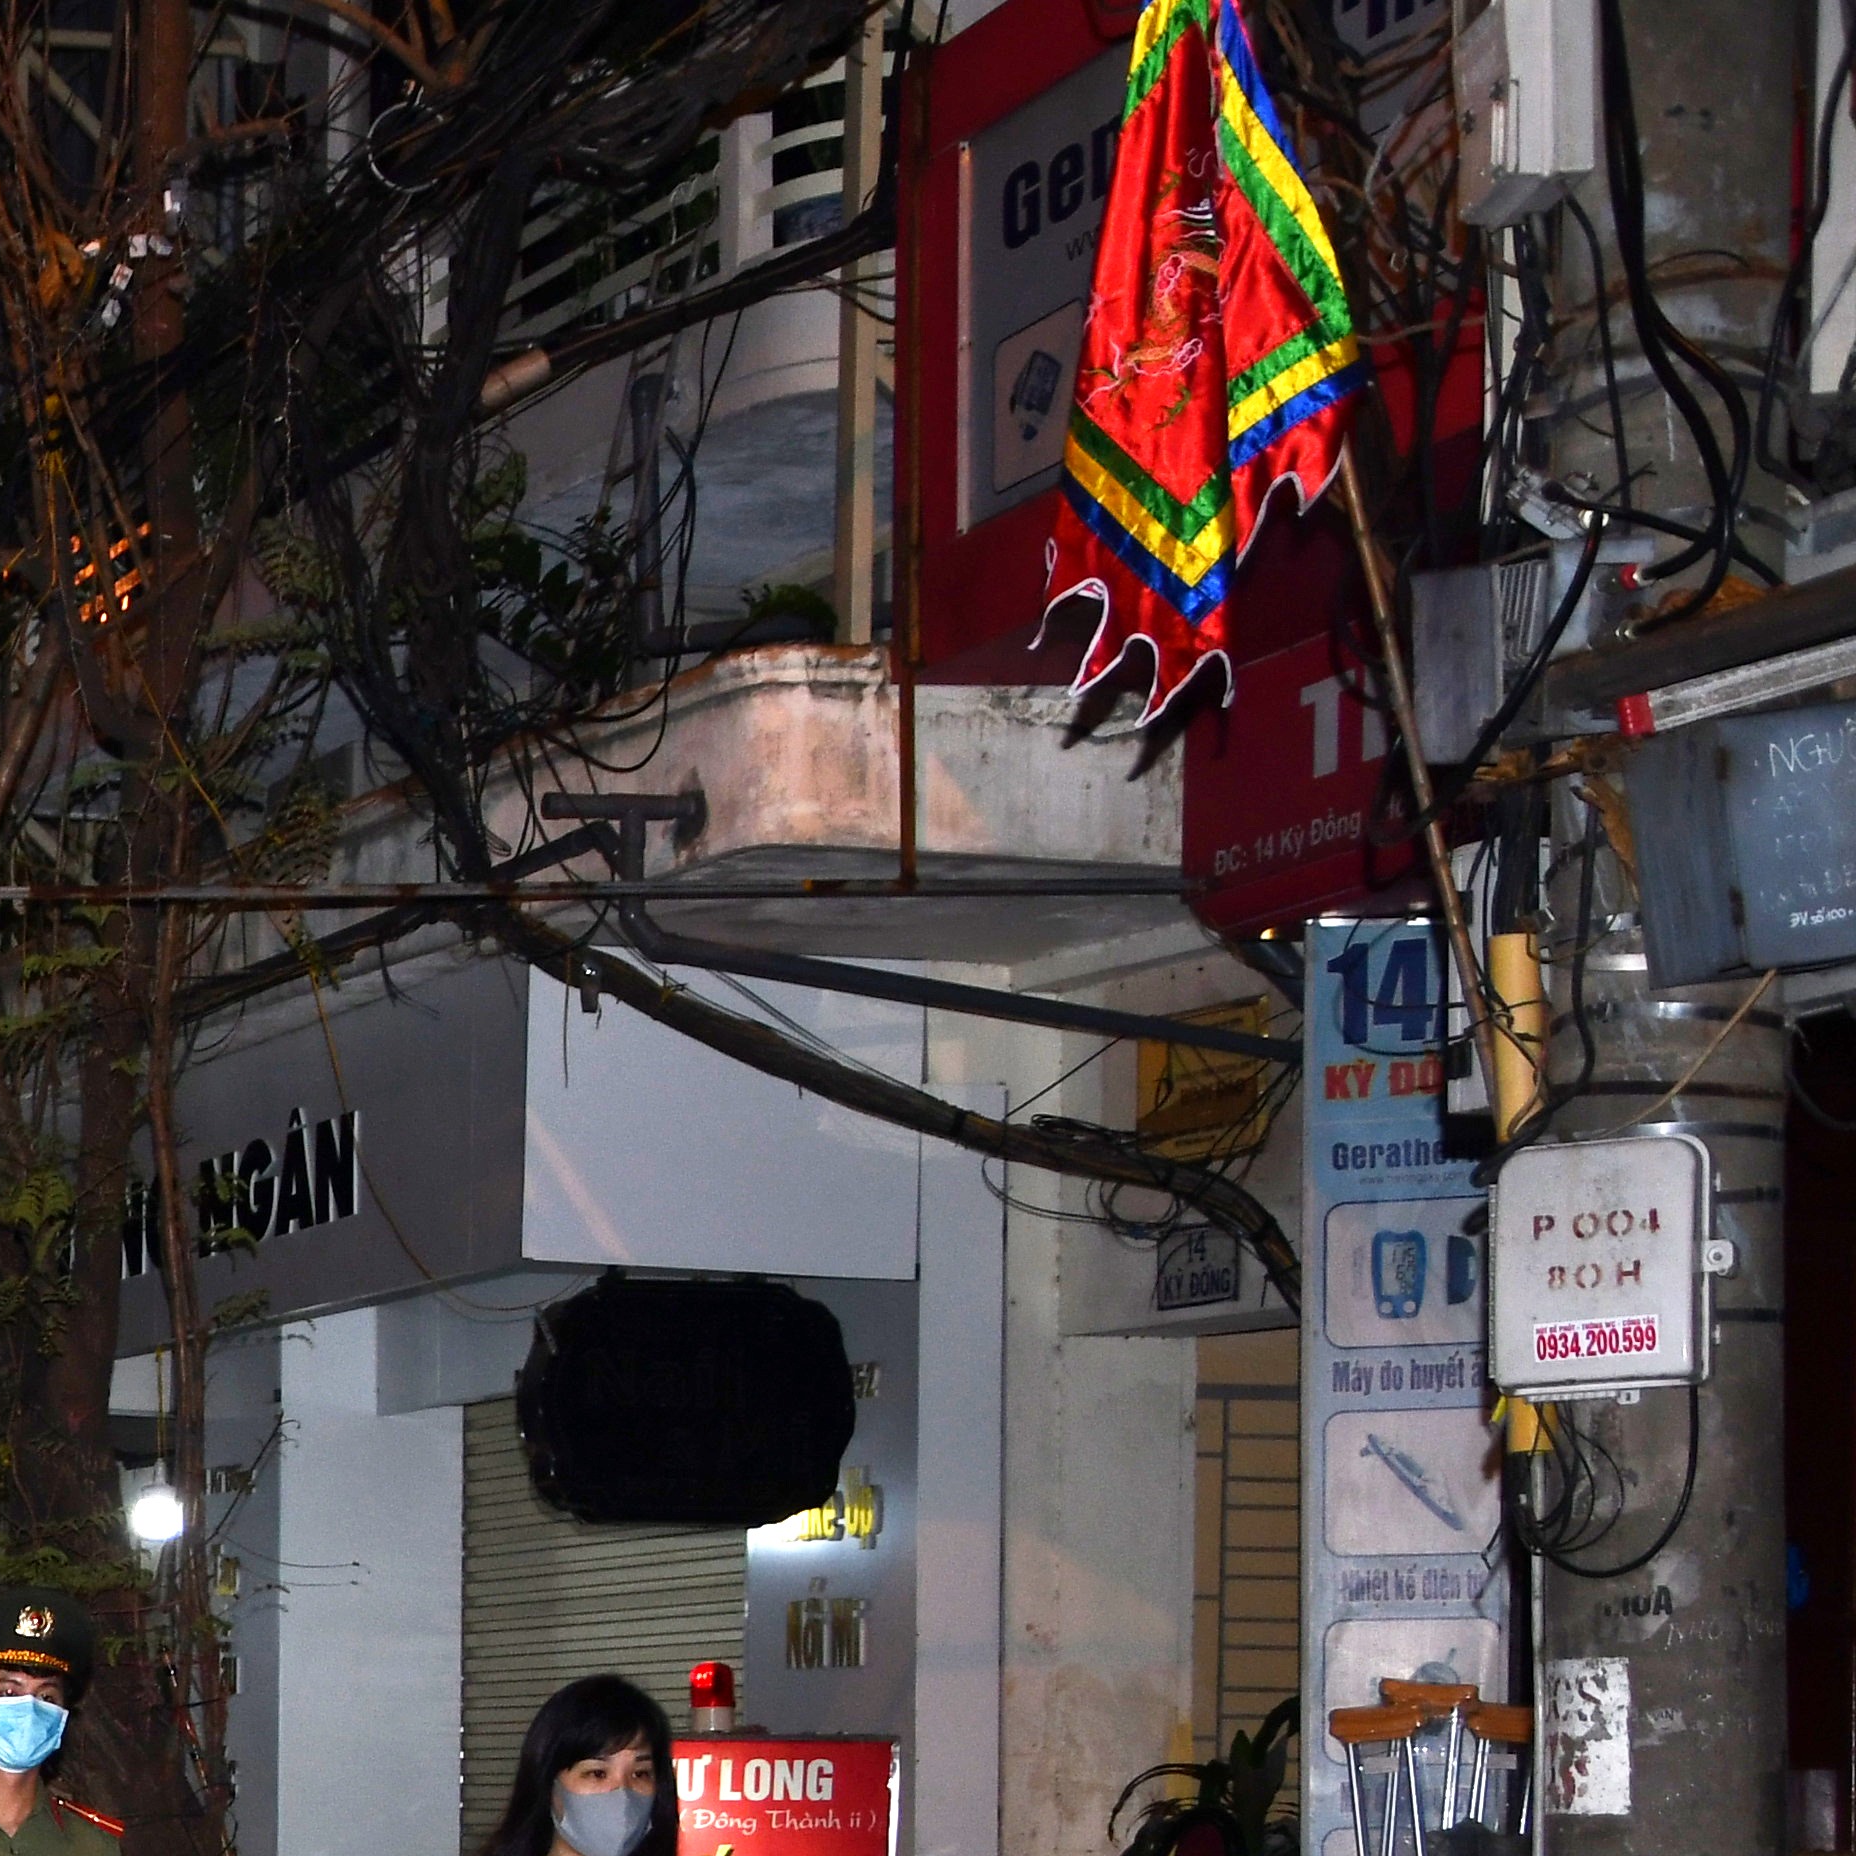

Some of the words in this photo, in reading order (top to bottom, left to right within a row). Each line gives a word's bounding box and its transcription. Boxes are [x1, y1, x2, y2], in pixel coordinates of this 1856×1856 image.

[1327, 937, 1440, 1045] 14
[1324, 1058, 1375, 1100] KỲ
[1390, 1050, 1445, 1096] ĐỒ
[1332, 1137, 1463, 1170] Gerathe
[199, 1107, 359, 1259] NGÂN
[1533, 1214, 1555, 1241] P
[1536, 1324, 1657, 1361] 0934.200.599
[1333, 1360, 1374, 1395] Máy
[1410, 1350, 1465, 1393] huyết
[719, 1757, 834, 1802] LONG
[692, 1808, 758, 1834] Đông
[765, 1808, 842, 1835] Thành
